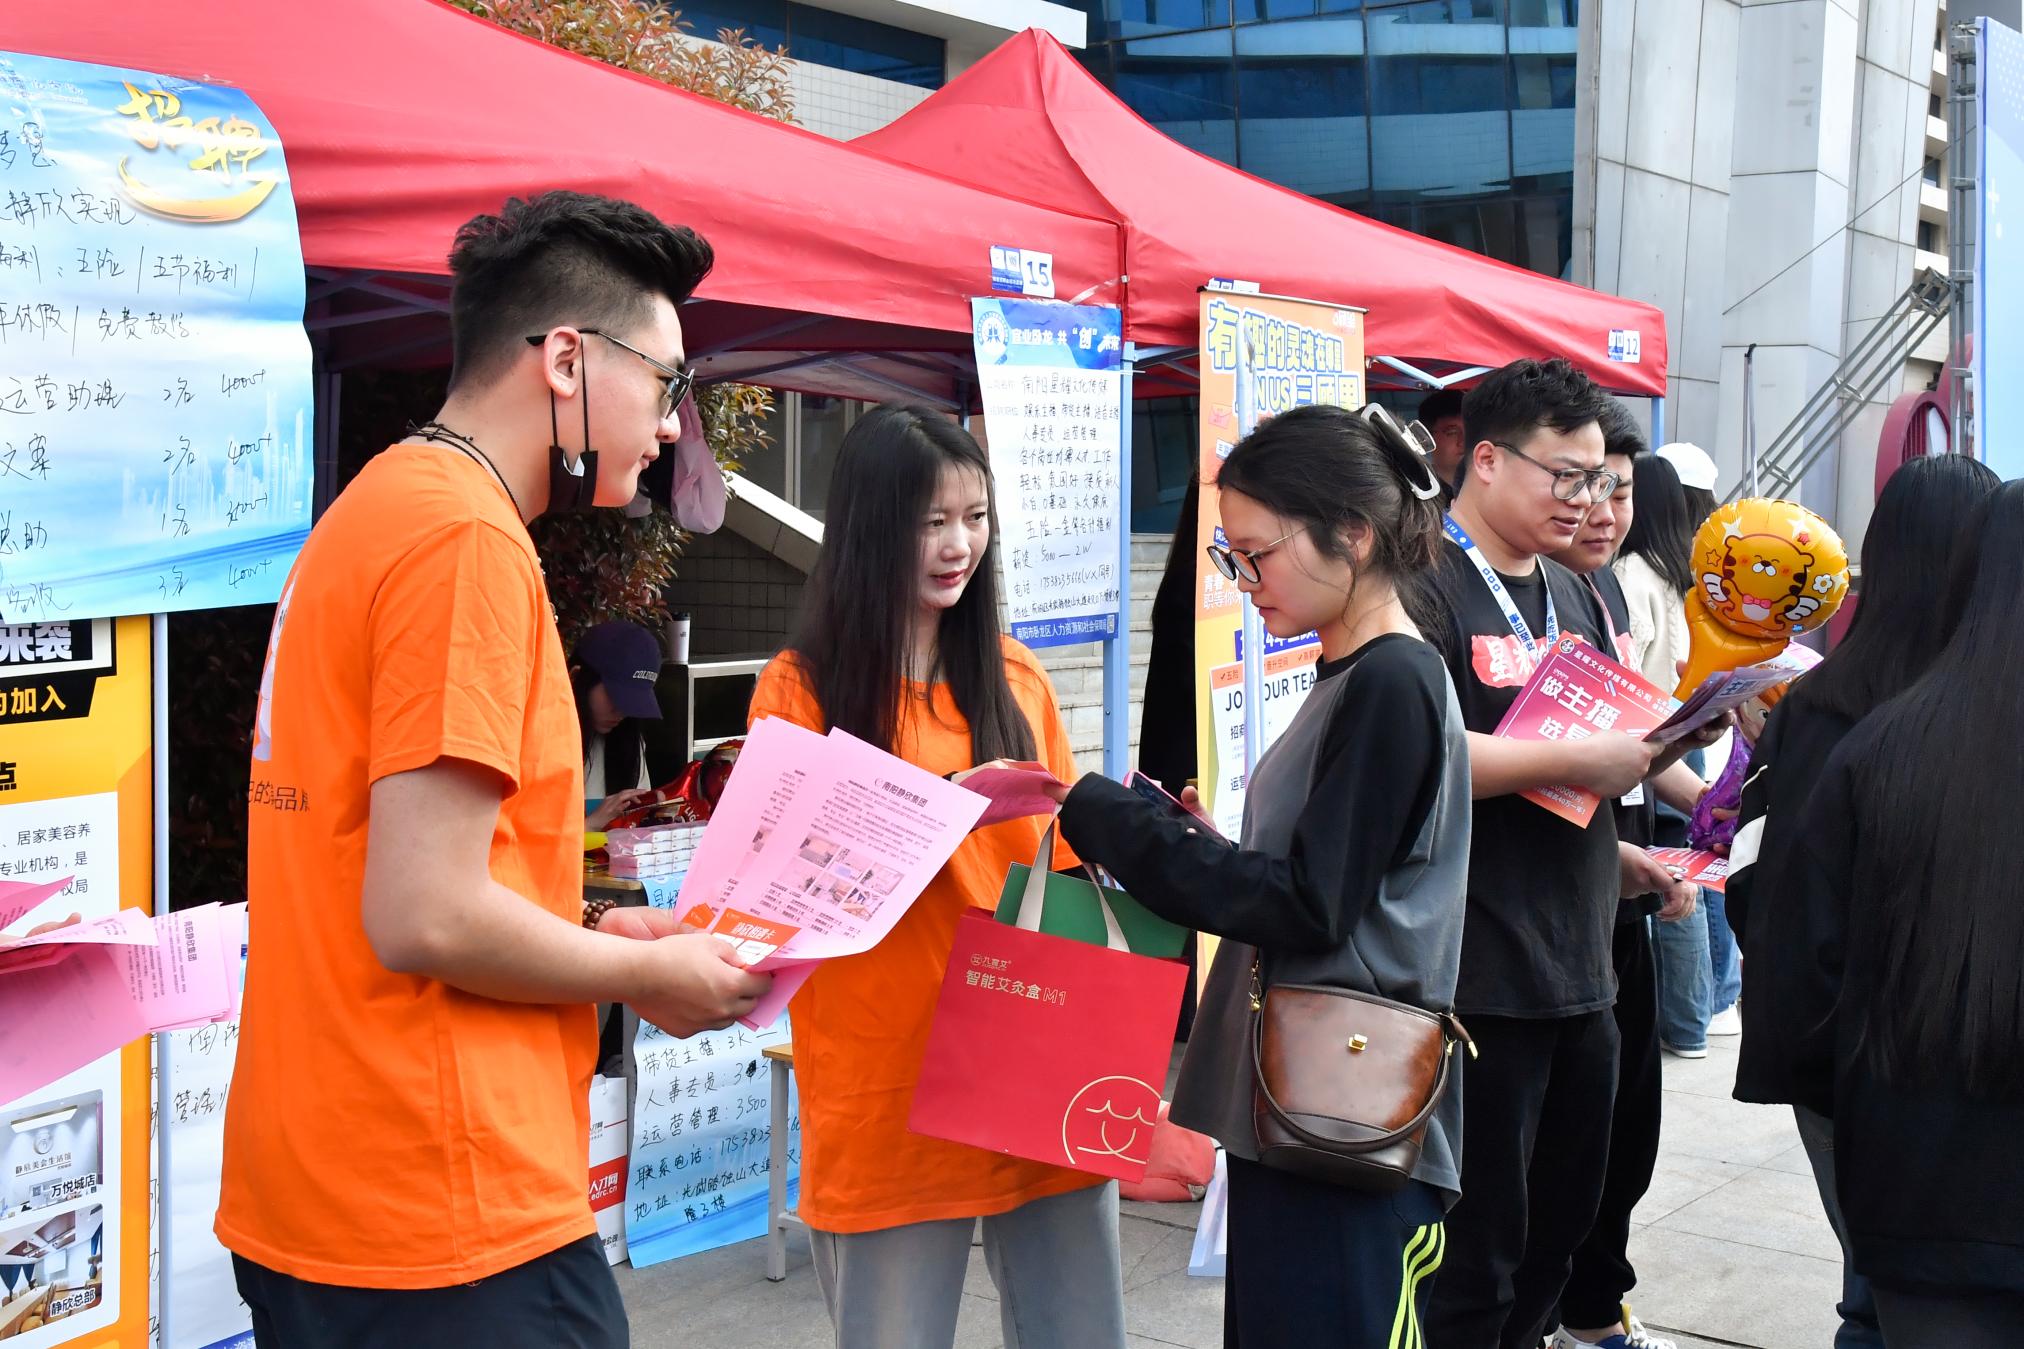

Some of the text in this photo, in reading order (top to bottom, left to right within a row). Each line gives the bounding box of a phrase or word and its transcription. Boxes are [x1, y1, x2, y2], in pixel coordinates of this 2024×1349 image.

[1027, 261, 1050, 287] 15
[1540, 675, 1621, 731] 做主播
[966, 969, 1068, 1006] 智能艾灸盒 M1
[52, 1174, 96, 1198] 万悦城店
[51, 1289, 96, 1316] 静欣总部
